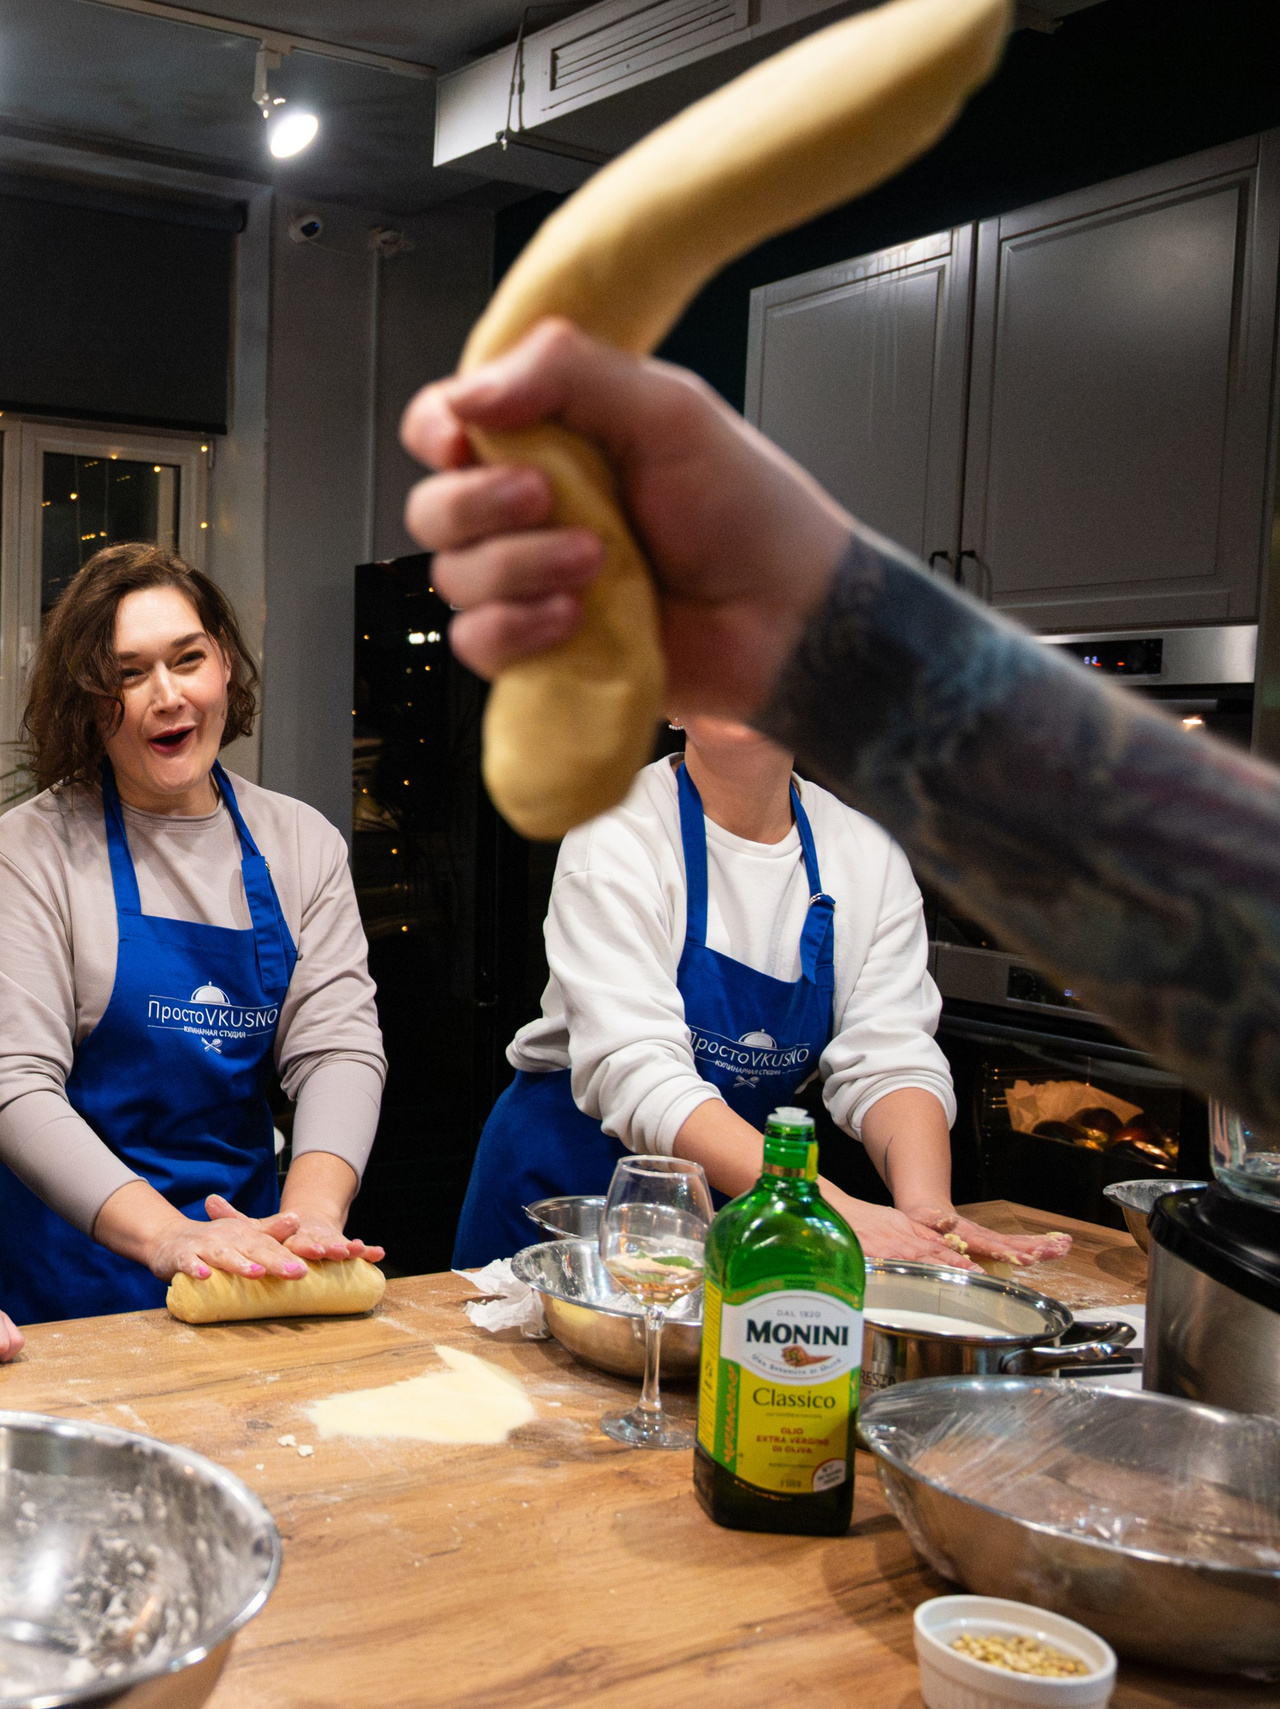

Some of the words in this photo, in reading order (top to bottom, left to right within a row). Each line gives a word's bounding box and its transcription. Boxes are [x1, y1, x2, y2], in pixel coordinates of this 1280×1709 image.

[148, 1000, 278, 1028] ПростоVKUSNO
[219, 1030, 246, 1039] СТУДИЯ
[746, 1319, 849, 1346] MONINI
[753, 1387, 836, 1409] Classico
[780, 1426, 804, 1435] OLIO
[756, 1435, 786, 1444] EXTRA
